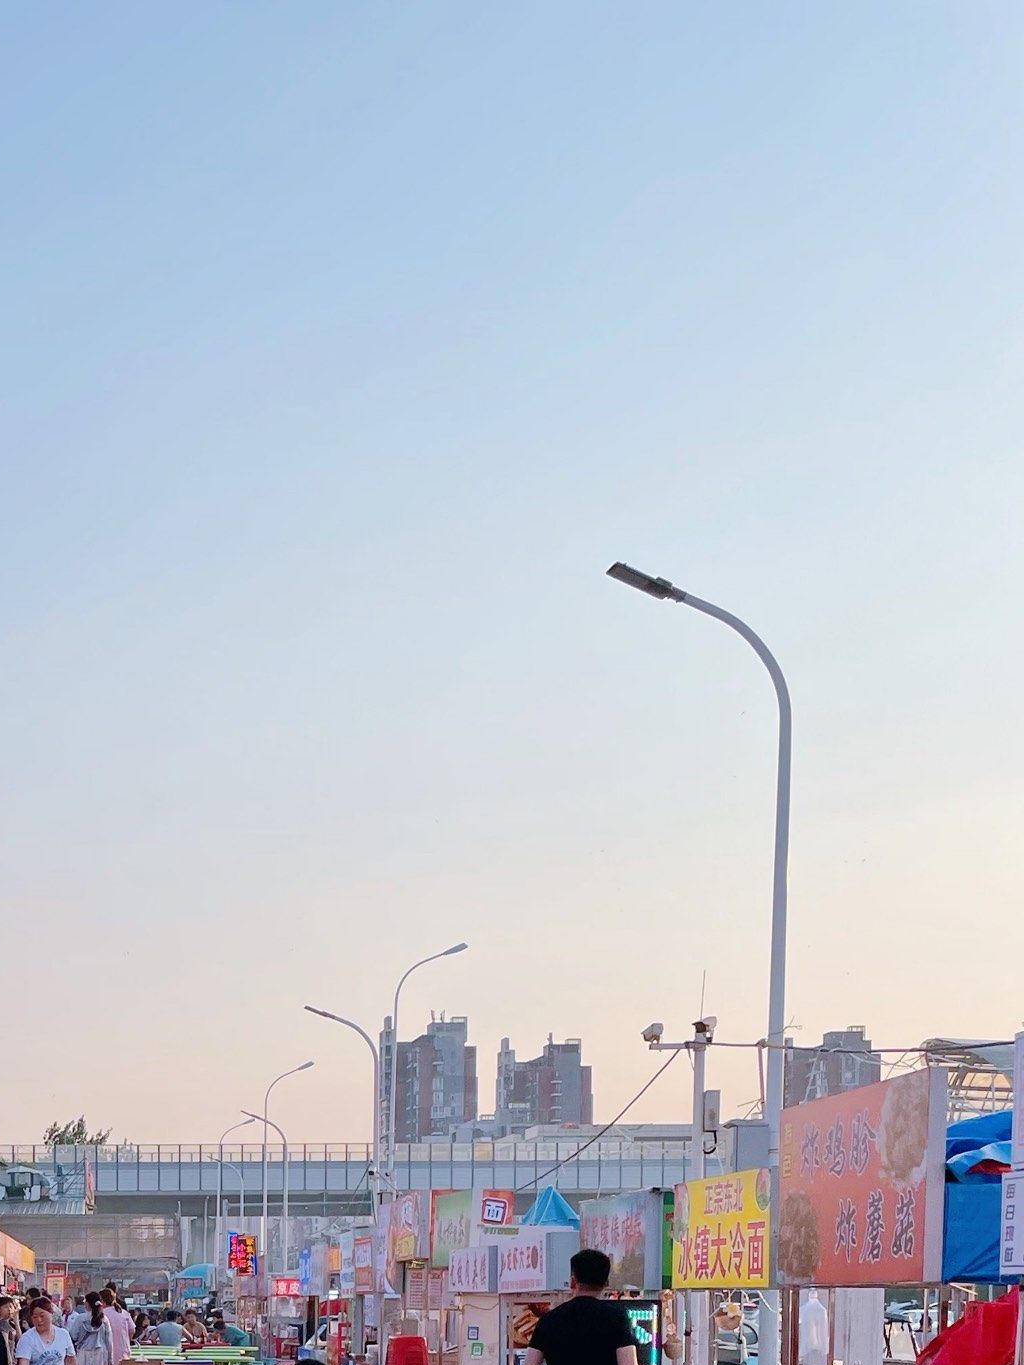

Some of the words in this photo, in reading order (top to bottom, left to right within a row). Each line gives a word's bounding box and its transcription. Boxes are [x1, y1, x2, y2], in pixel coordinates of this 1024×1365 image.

[677, 1221, 766, 1281] 冰镇大冷面
[835, 1187, 916, 1265] 炸蘑菇
